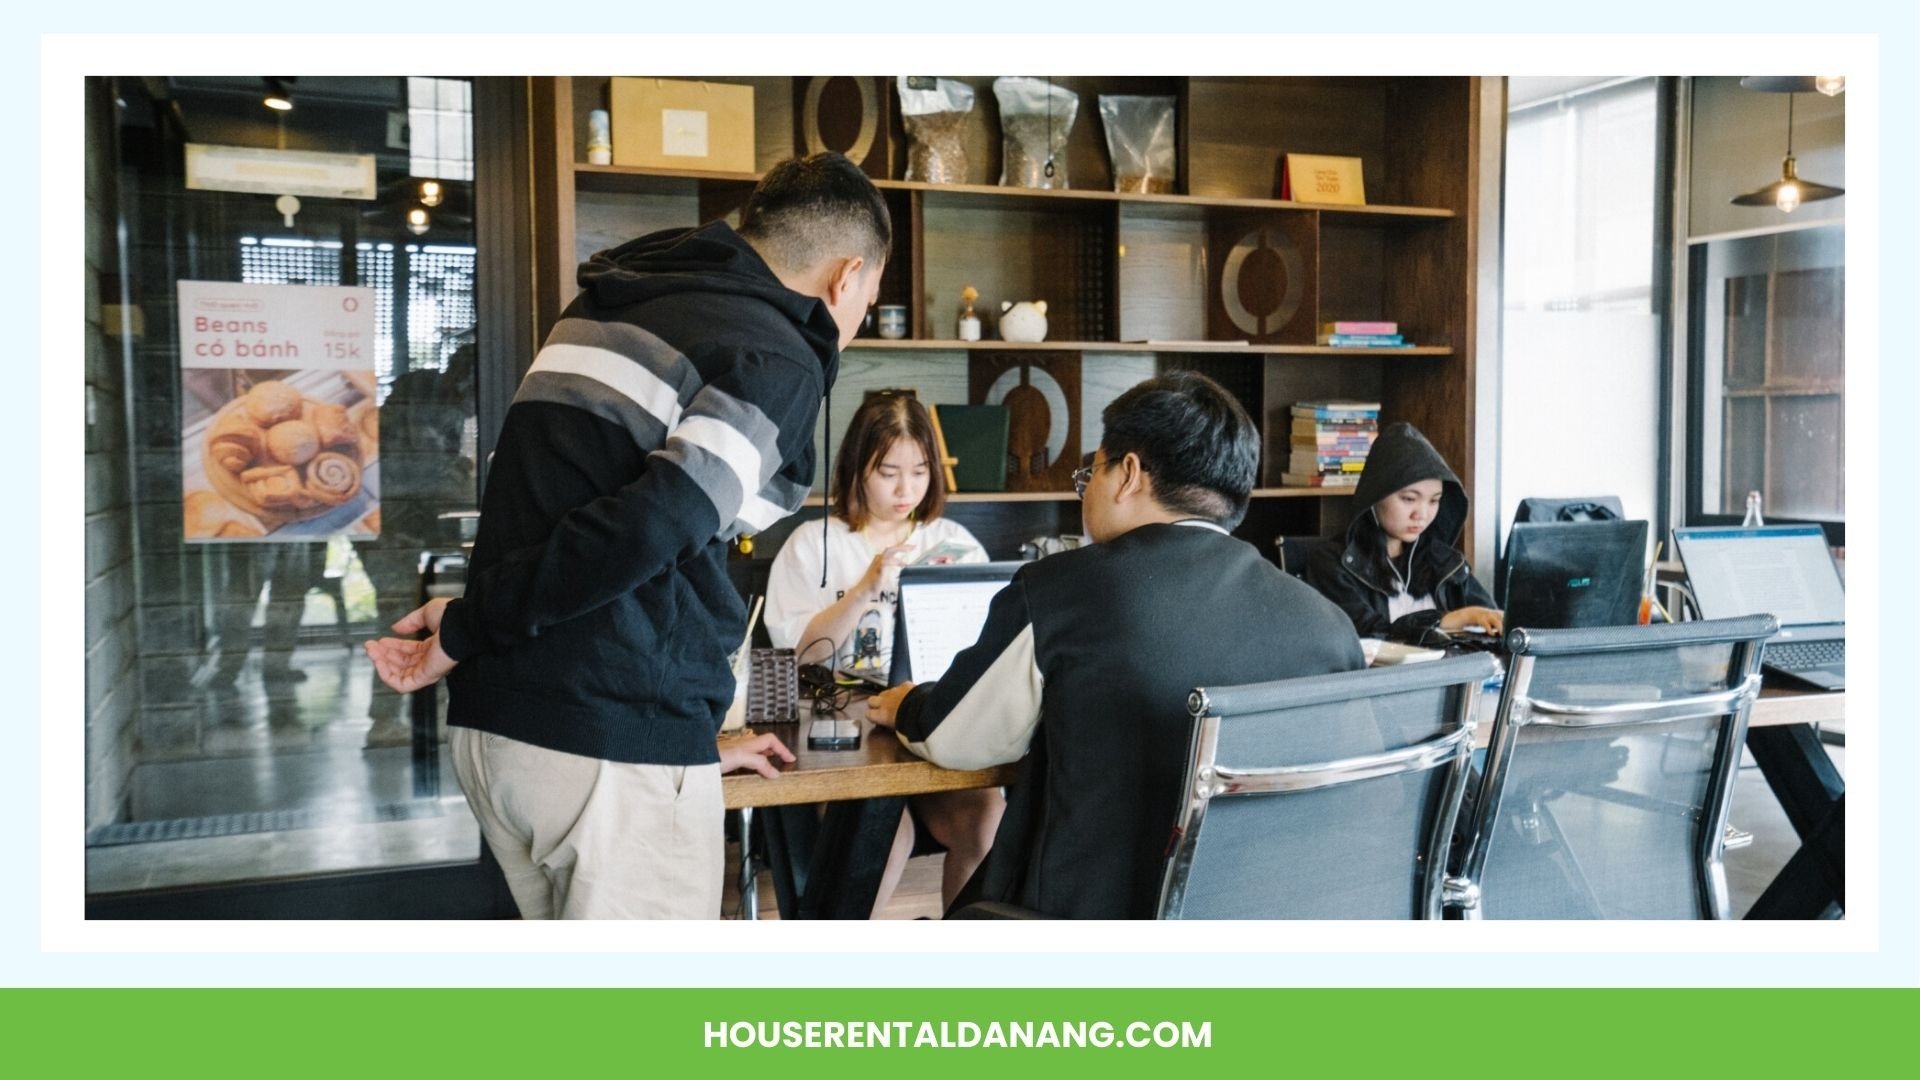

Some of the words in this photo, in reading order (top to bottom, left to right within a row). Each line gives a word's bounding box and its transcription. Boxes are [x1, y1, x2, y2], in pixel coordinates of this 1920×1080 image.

[194, 316, 268, 334] Beans
[195, 339, 225, 357] có
[235, 339, 299, 358] bánh
[324, 342, 361, 360] 15k
